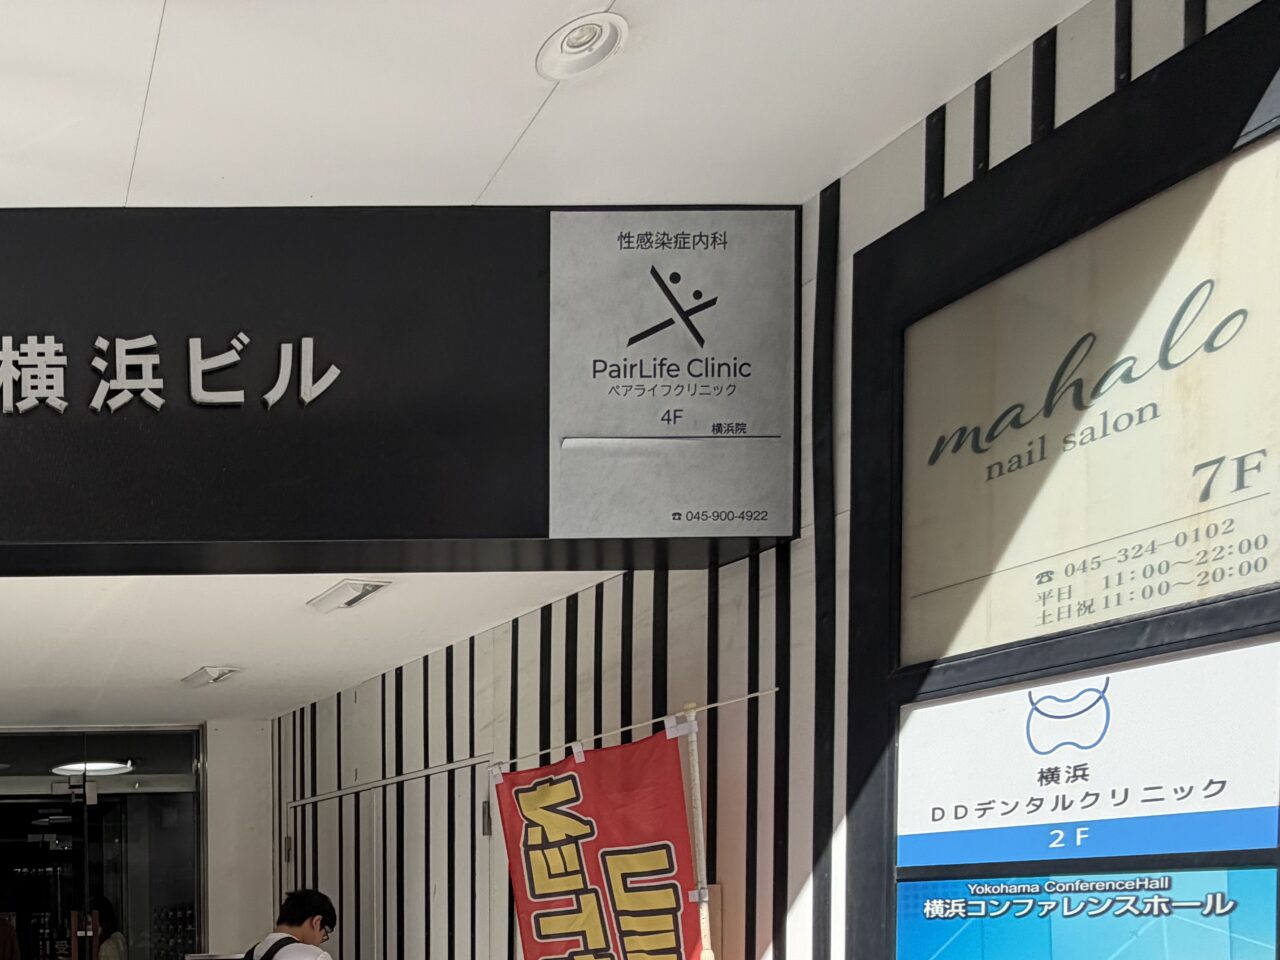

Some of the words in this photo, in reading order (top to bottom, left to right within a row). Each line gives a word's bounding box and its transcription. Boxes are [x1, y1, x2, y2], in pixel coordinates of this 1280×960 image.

[617, 230, 729, 251] 性感染症内科
[592, 357, 681, 379] PairLife
[687, 357, 752, 379] Clinic
[927, 278, 1249, 466] mahalo
[607, 383, 738, 398] ペアライフクリニック
[660, 408, 684, 425] 4F
[711, 422, 748, 435] 横浜院
[985, 435, 1048, 482] nail
[1062, 401, 1161, 452] salon
[1192, 448, 1268, 503] 7F
[685, 509, 769, 522] 045-900-4922
[1064, 518, 1235, 578] 045-324-0102
[1035, 585, 1073, 607] 平日
[1034, 598, 1096, 627] 土日祝
[1037, 763, 1090, 787] 横浜
[967, 881, 1040, 897] Yokohama
[1044, 876, 1172, 895] ConferenceHall
[922, 892, 1237, 921] 横浜コンファレンスホール
